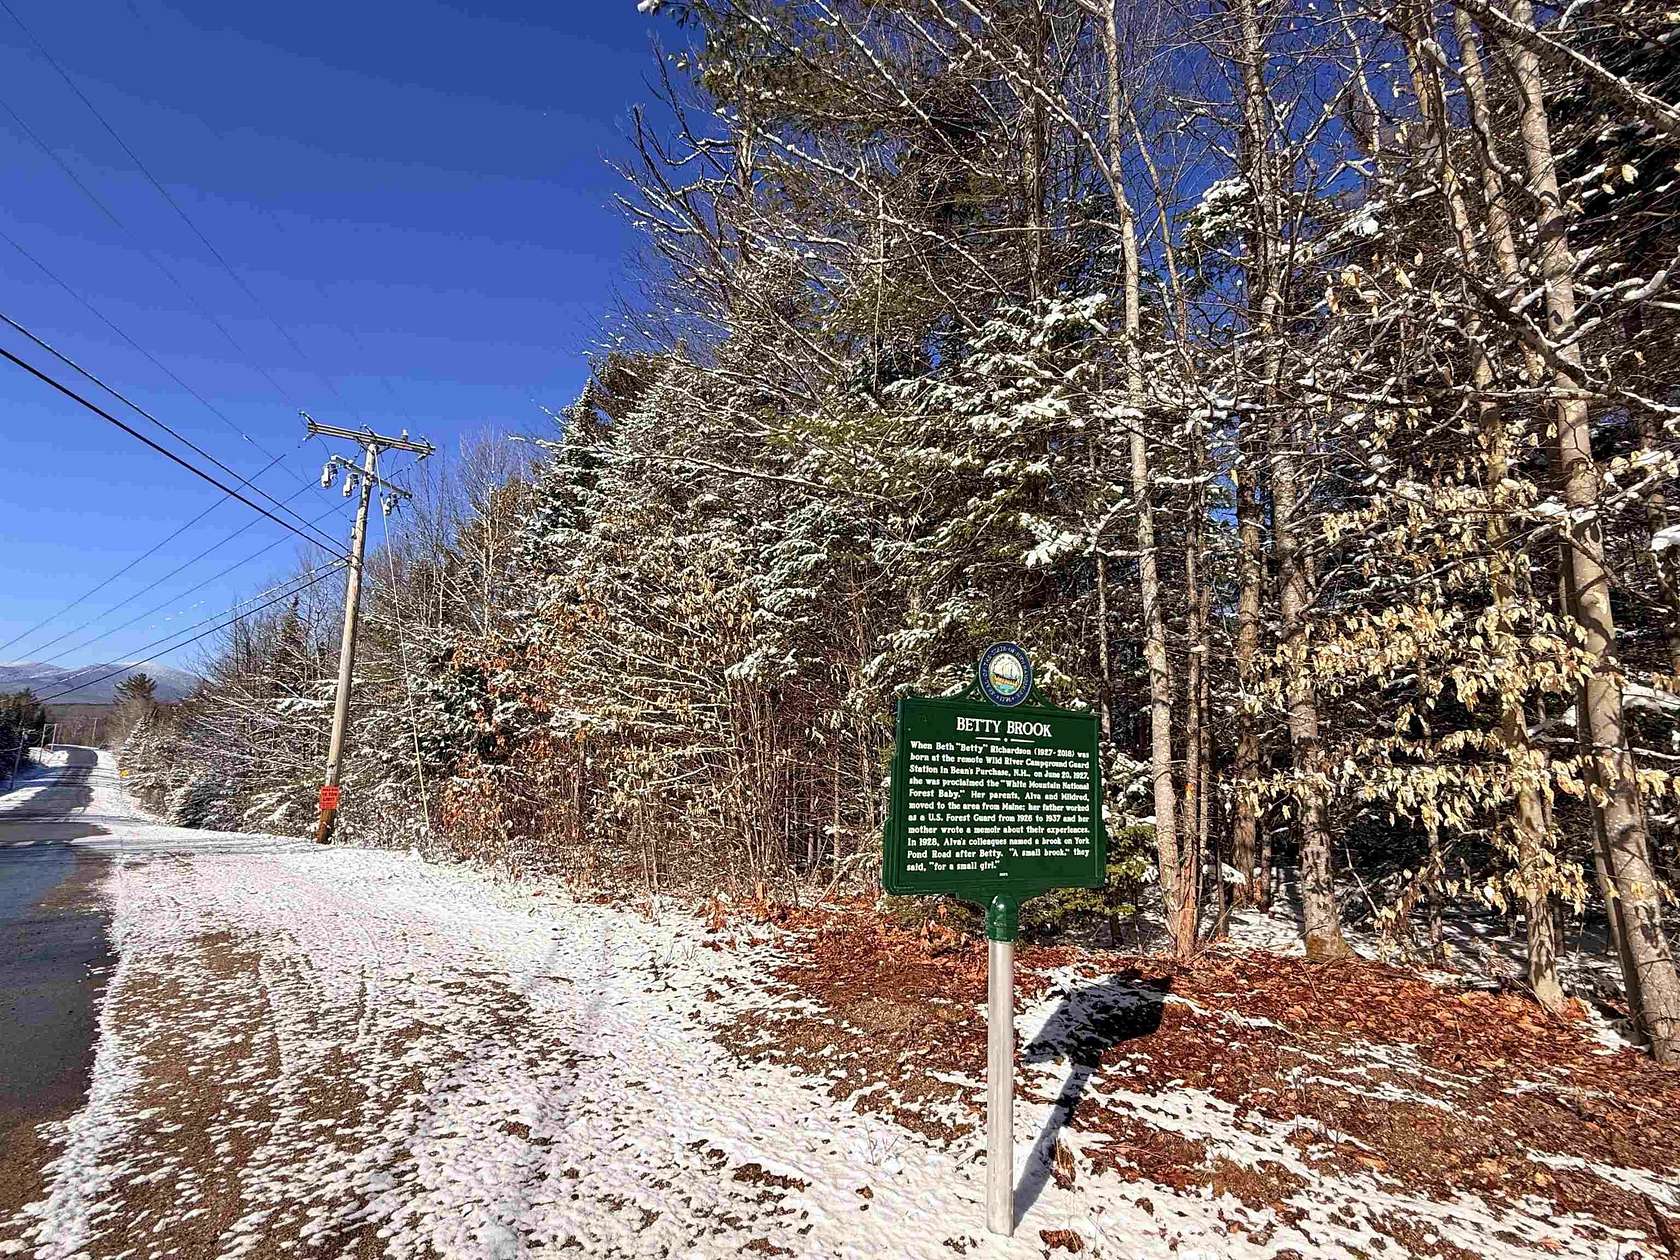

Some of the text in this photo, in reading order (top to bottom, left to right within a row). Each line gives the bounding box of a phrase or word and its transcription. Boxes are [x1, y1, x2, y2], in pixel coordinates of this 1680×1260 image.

[956, 717, 1052, 737] BETTY BROOK
[910, 740, 932, 750] When
[936, 742, 954, 751] Beth
[956, 742, 988, 754] "Betty"
[990, 745, 1031, 755] Richardson
[910, 752, 929, 761] born
[942, 754, 955, 762] the
[985, 756, 1002, 764] Wild
[1004, 757, 1024, 766] River
[1025, 758, 1068, 768] Campground
[1068, 760, 1089, 769] Guard
[909, 764, 938, 774] Station
[950, 766, 974, 775] Bean's
[1044, 770, 1060, 778] June
[909, 776, 923, 785] she
[942, 778, 984, 787] proclaimed
[986, 779, 1000, 787] the
[1000, 780, 1026, 788] "White
[1028, 780, 1061, 789] Mountain
[1062, 782, 1089, 790] National
[909, 788, 934, 797] Forest
[938, 789, 965, 800] Baby."
[971, 790, 986, 798] Her
[909, 801, 934, 810] moved
[936, 801, 945, 810] to
[948, 802, 961, 810] the
[982, 802, 1000, 810] from
[928, 813, 944, 821] U.S.
[946, 813, 970, 822] Forest
[998, 814, 1015, 822] from
[908, 825, 938, 834] mother
[940, 826, 964, 834] wrote
[974, 825, 1001, 834] memoir
[1026, 826, 1045, 834] their
[1046, 826, 1090, 835] experiences.
[908, 838, 916, 846] In
[943, 837, 966, 846] Alva's
[968, 837, 1007, 847] colleagues
[907, 850, 928, 858] Pond
[932, 850, 952, 858] Road
[955, 850, 976, 858] after
[979, 849, 1003, 859] Betty.
[1009, 848, 1018, 857] "A
[1073, 848, 1090, 857] they
[906, 862, 926, 872] said,
[929, 862, 947, 870] "for
[956, 862, 977, 870] small
[980, 860, 1000, 871] girl."
